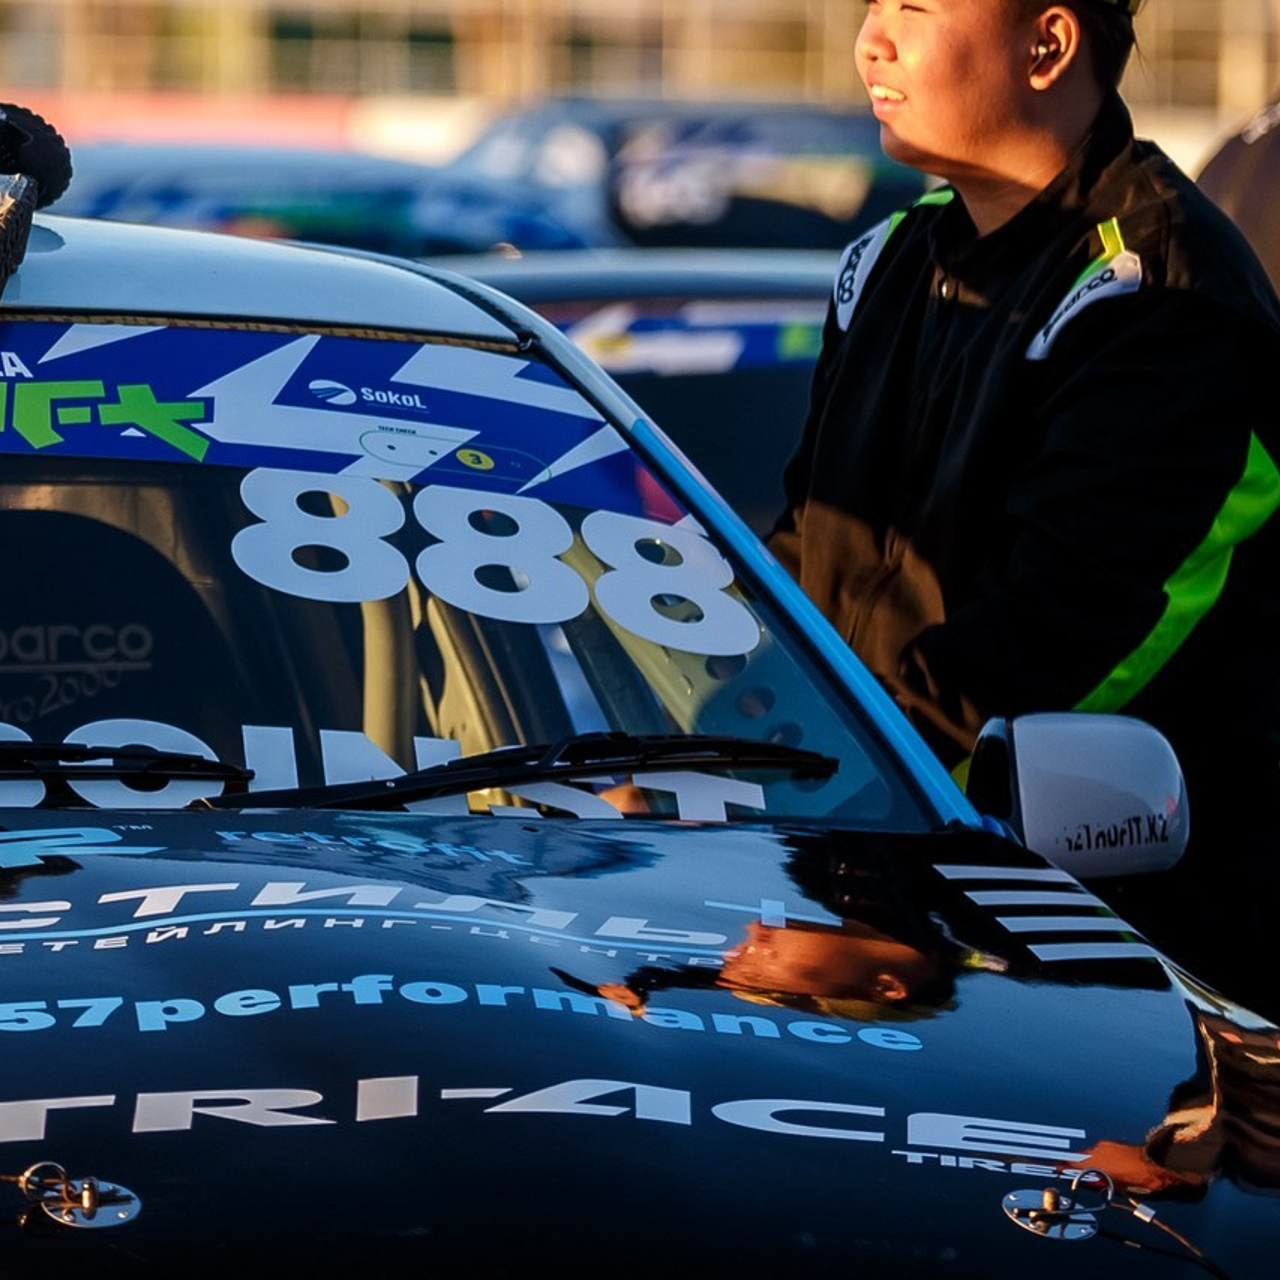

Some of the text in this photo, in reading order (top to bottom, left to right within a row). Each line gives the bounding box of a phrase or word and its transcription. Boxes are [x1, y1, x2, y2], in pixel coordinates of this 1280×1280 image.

[231, 466, 761, 657] 888
[1056, 813, 1170, 852] TROFIT.KZ
[891, 1150, 1101, 1183] TIRES
